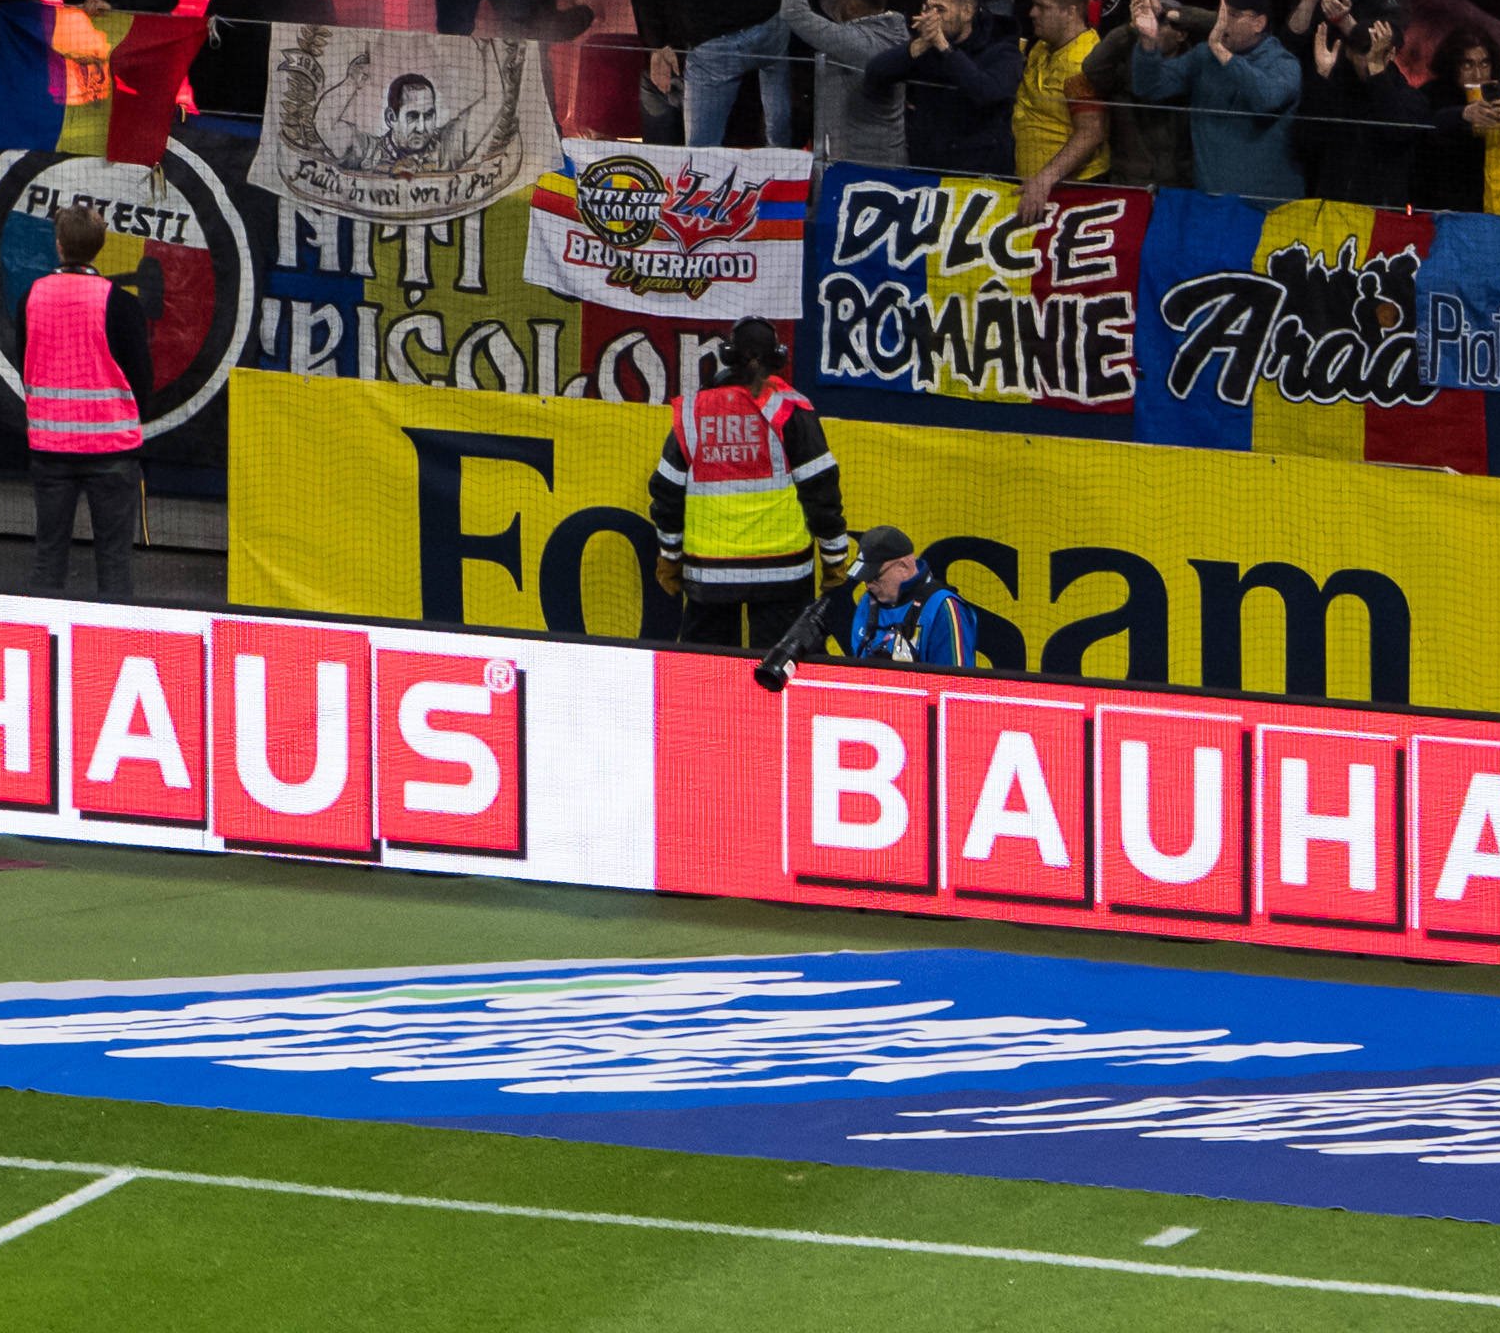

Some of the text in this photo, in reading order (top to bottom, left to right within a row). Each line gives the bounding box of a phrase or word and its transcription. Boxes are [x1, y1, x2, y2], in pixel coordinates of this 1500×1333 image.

[568, 235, 754, 279] BROTHERHOOD
[832, 181, 1128, 287] DULCE
[817, 272, 1138, 405] ROMÂNIE
[700, 413, 762, 444] FIRE
[701, 444, 762, 465] SAFETY
[401, 426, 1412, 707] Fosam
